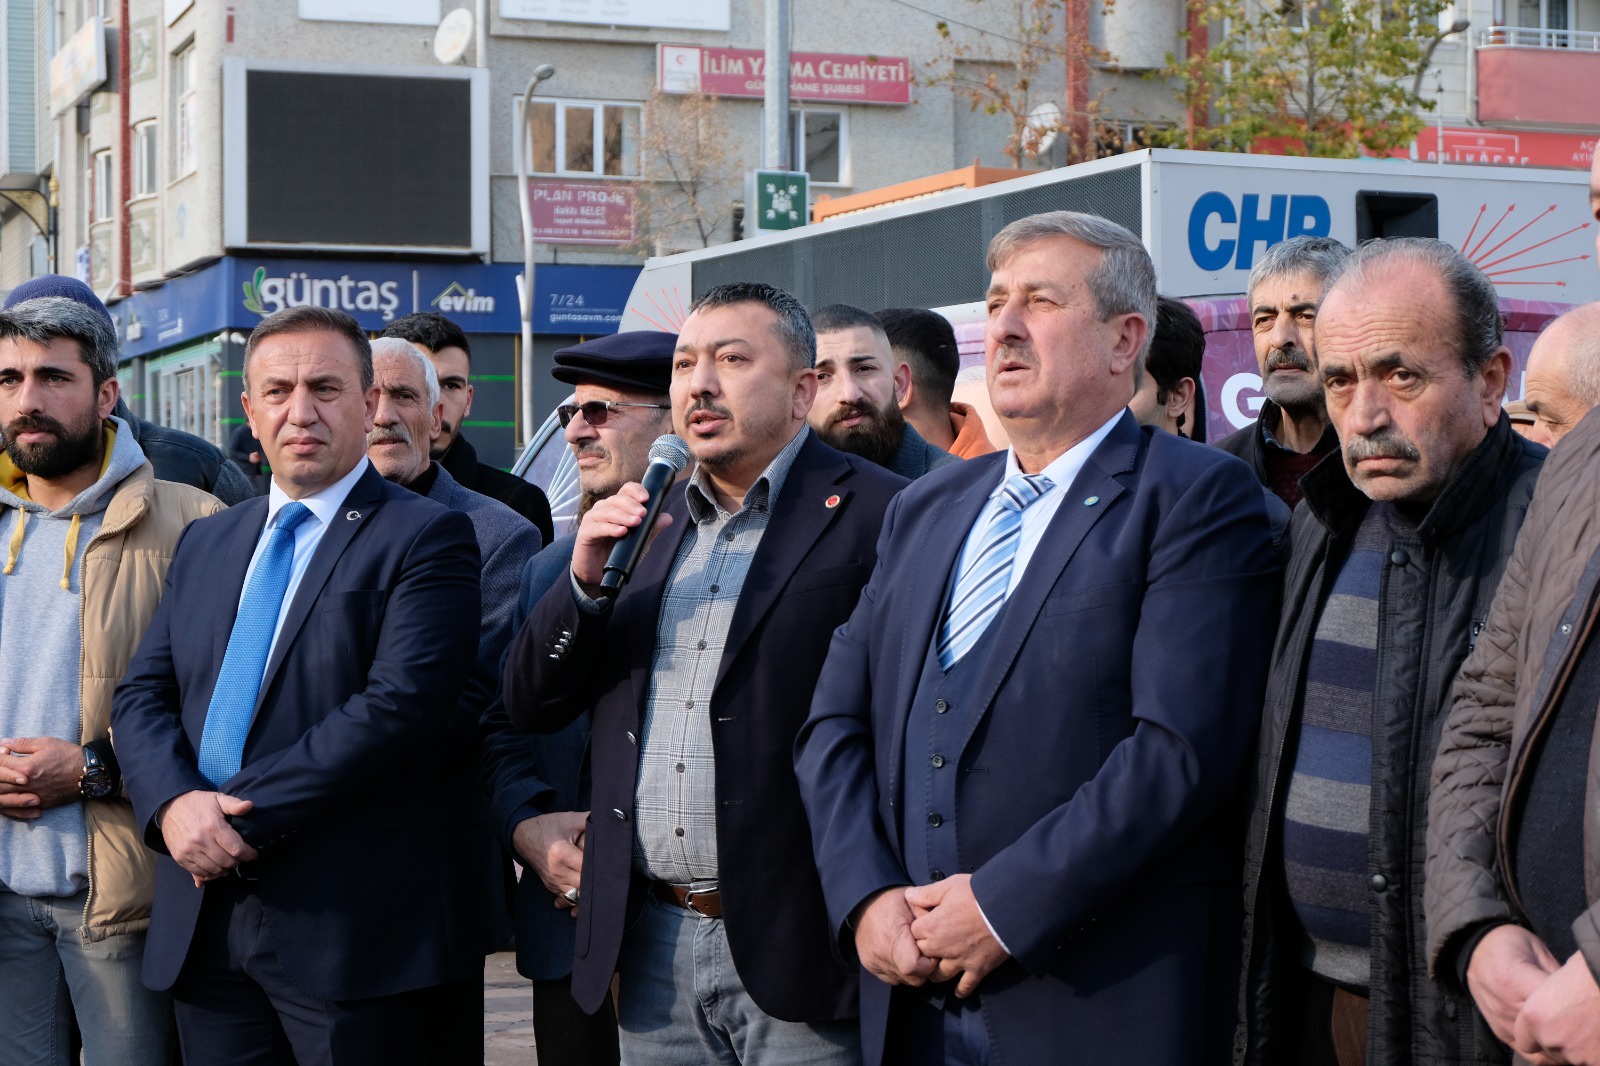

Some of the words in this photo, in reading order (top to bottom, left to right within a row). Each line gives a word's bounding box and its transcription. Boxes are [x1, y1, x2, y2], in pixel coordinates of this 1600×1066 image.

[703, 50, 744, 75] İLİM
[747, 56, 815, 78] YMA
[818, 60, 906, 82] CEMİYETİ
[823, 82, 866, 95] ŞUBESİ
[533, 189, 573, 202] PLAN
[1188, 190, 1332, 271] CHP
[260, 272, 399, 322] güntaş
[438, 288, 495, 312] evim
[550, 293, 584, 306] 7/24
